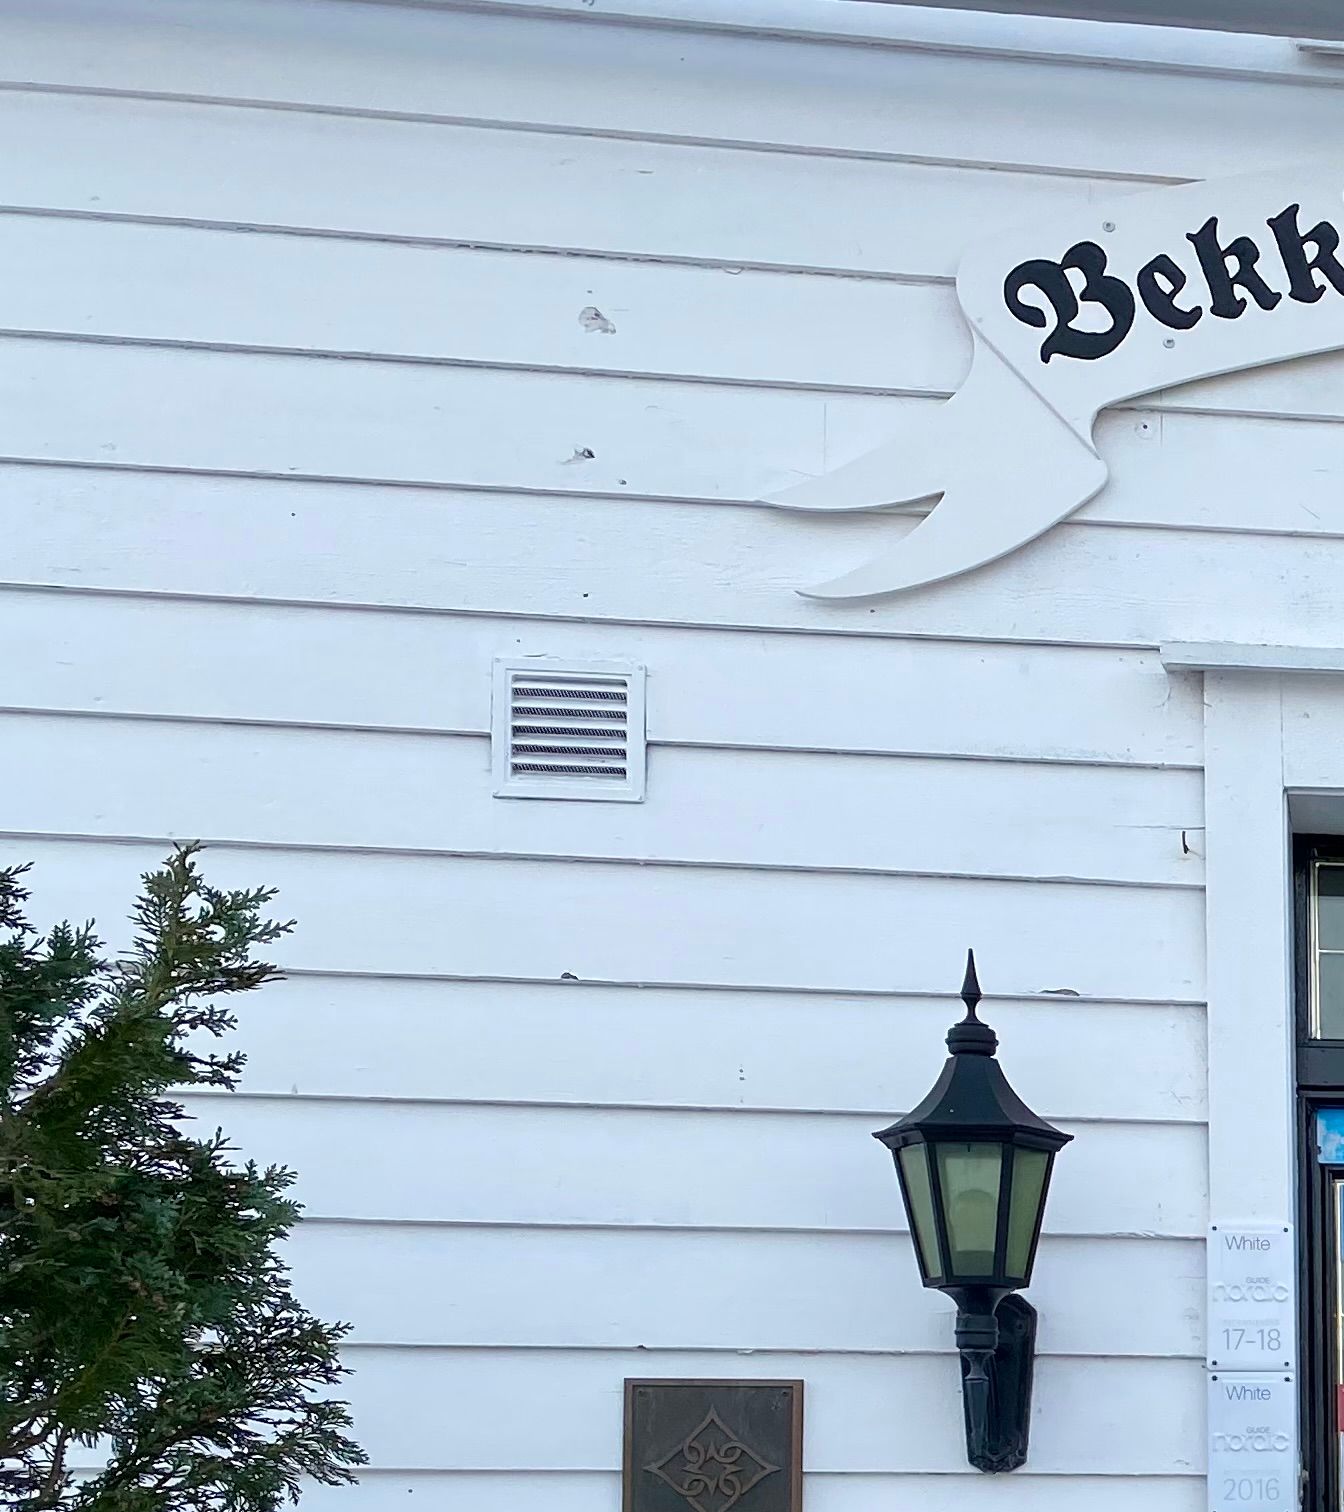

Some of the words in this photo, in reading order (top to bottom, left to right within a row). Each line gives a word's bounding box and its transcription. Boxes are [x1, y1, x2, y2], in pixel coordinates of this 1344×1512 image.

[1225, 1235, 1271, 1251] White
[1226, 1385, 1271, 1401] White
[1223, 1478, 1281, 1501] 2016
